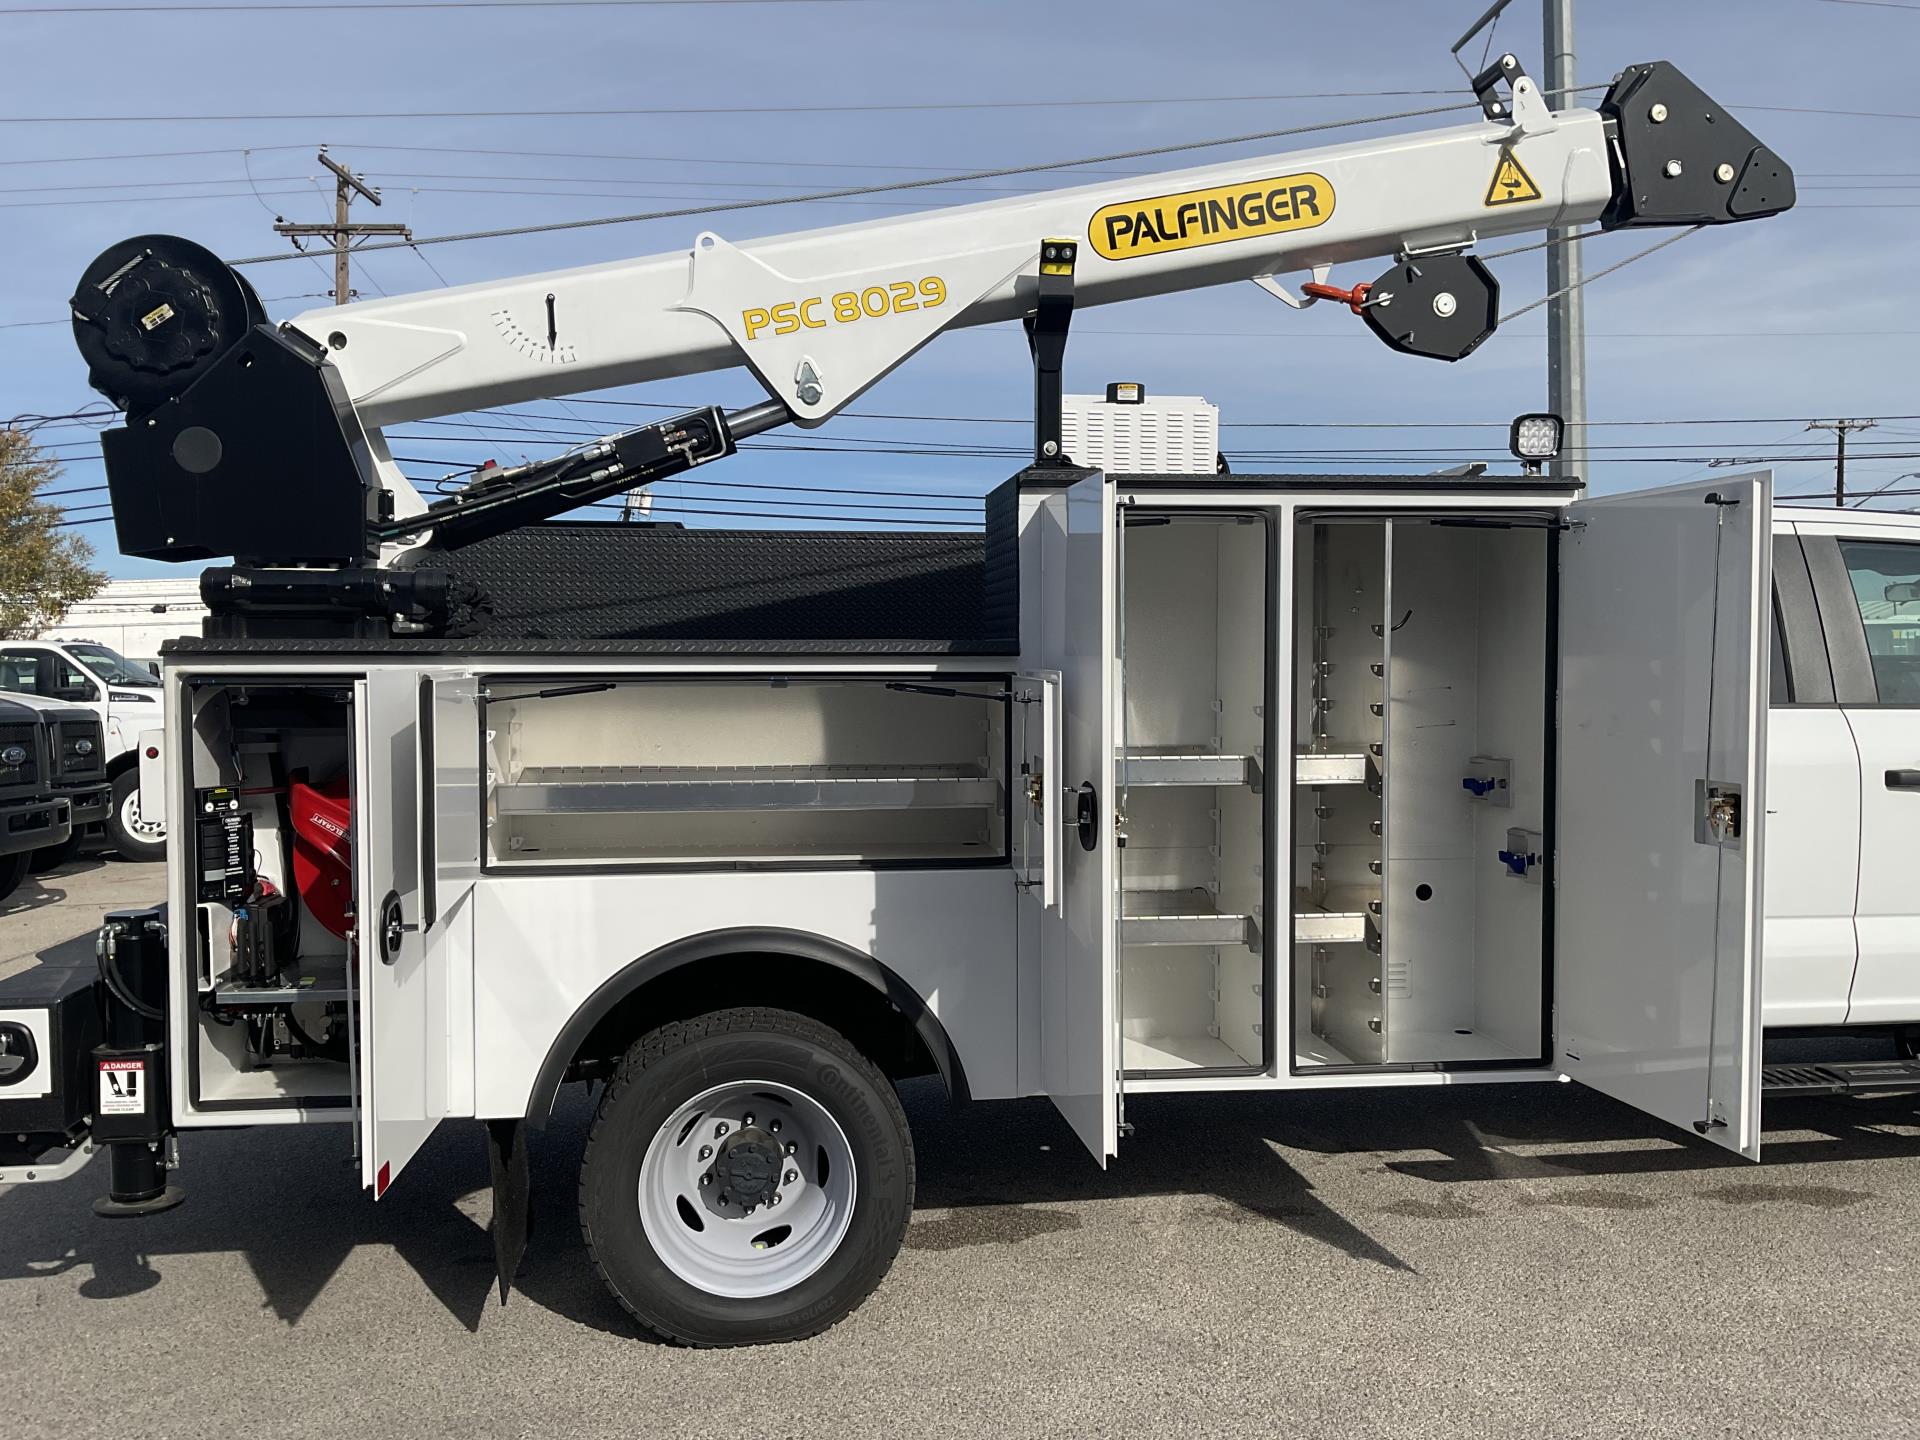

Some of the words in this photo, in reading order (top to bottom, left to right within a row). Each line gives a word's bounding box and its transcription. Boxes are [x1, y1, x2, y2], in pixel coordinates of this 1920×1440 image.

[1105, 184, 1320, 250] PALFINGER
[742, 296, 826, 340] PSC
[831, 276, 947, 323] 8029
[110, 1062, 142, 1070] DANGER
[817, 1064, 893, 1166] Continental
